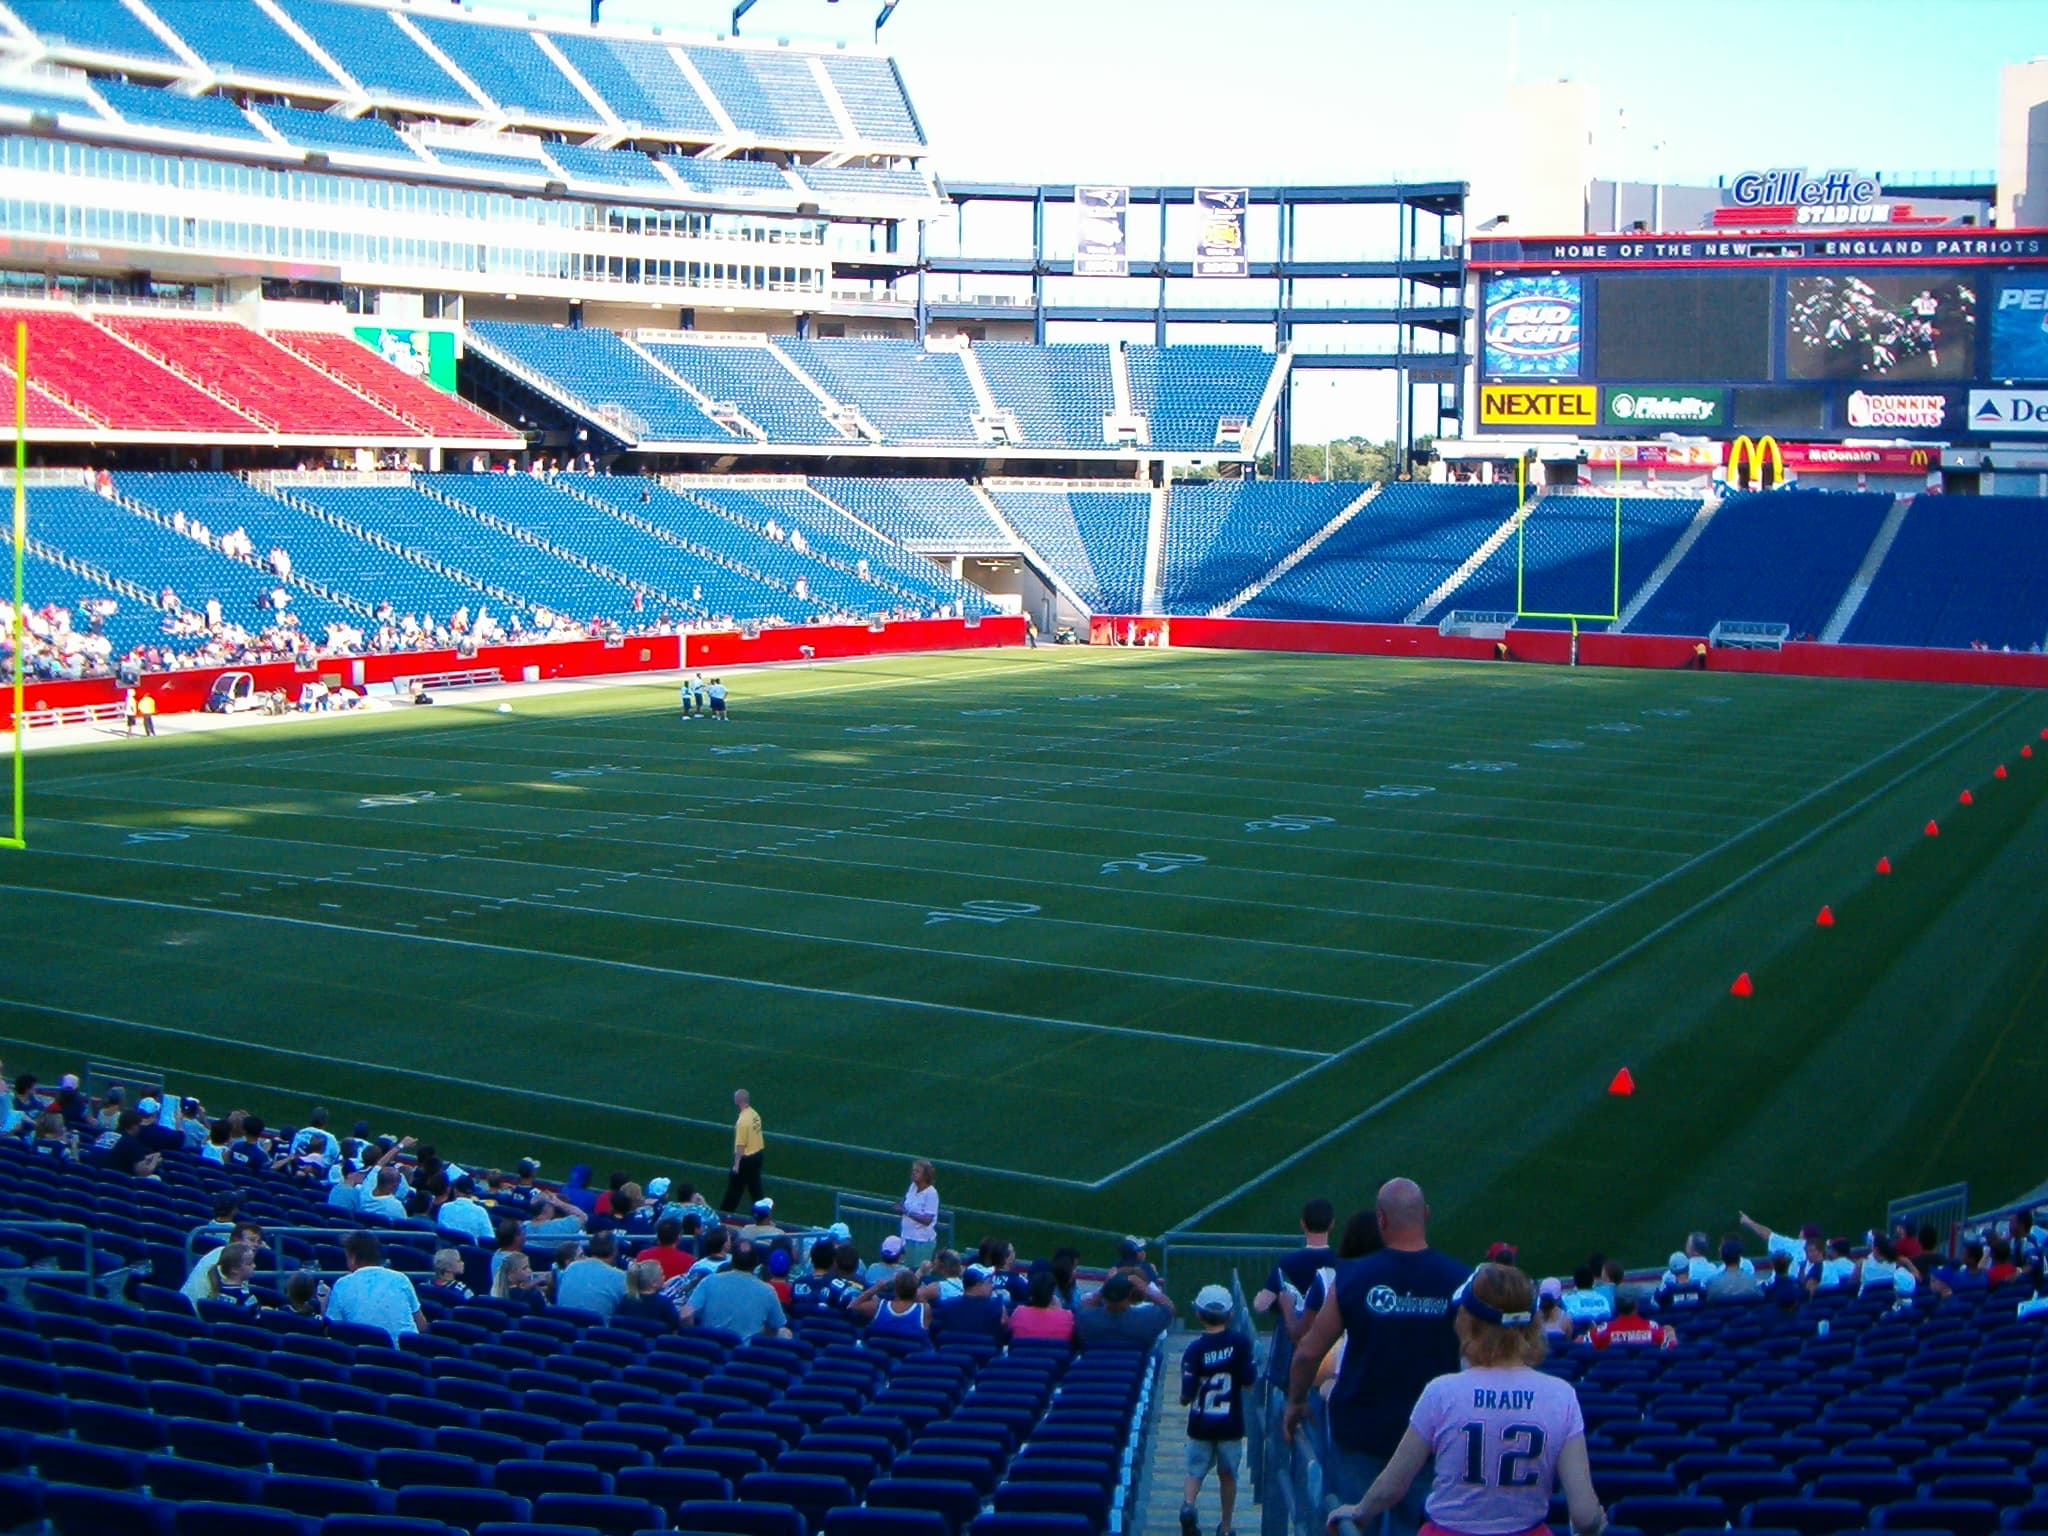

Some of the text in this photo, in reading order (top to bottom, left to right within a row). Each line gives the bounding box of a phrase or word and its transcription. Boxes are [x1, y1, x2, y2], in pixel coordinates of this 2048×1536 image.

[1733, 170, 1875, 206] Gillette
[1797, 205, 1890, 224] STADIUM
[1554, 240, 2040, 258] HOME OF THE NEW ENGLAND PATRIOTS
[1997, 288, 2048, 311] PE
[1505, 306, 1571, 325] BUD
[1490, 325, 1580, 344] LIGHT
[1485, 393, 1592, 416] NEXTEL
[1634, 396, 1716, 420] Fidelity
[1872, 412, 1940, 425] DONUTS
[1808, 449, 1881, 463] McDonald's
[1244, 813, 1336, 832] 30
[1100, 851, 1208, 875] 20
[924, 899, 1042, 926] 10
[1191, 1371, 1232, 1415] 12
[1473, 1388, 1535, 1410] BRADY
[1461, 1421, 1547, 1487] 12
